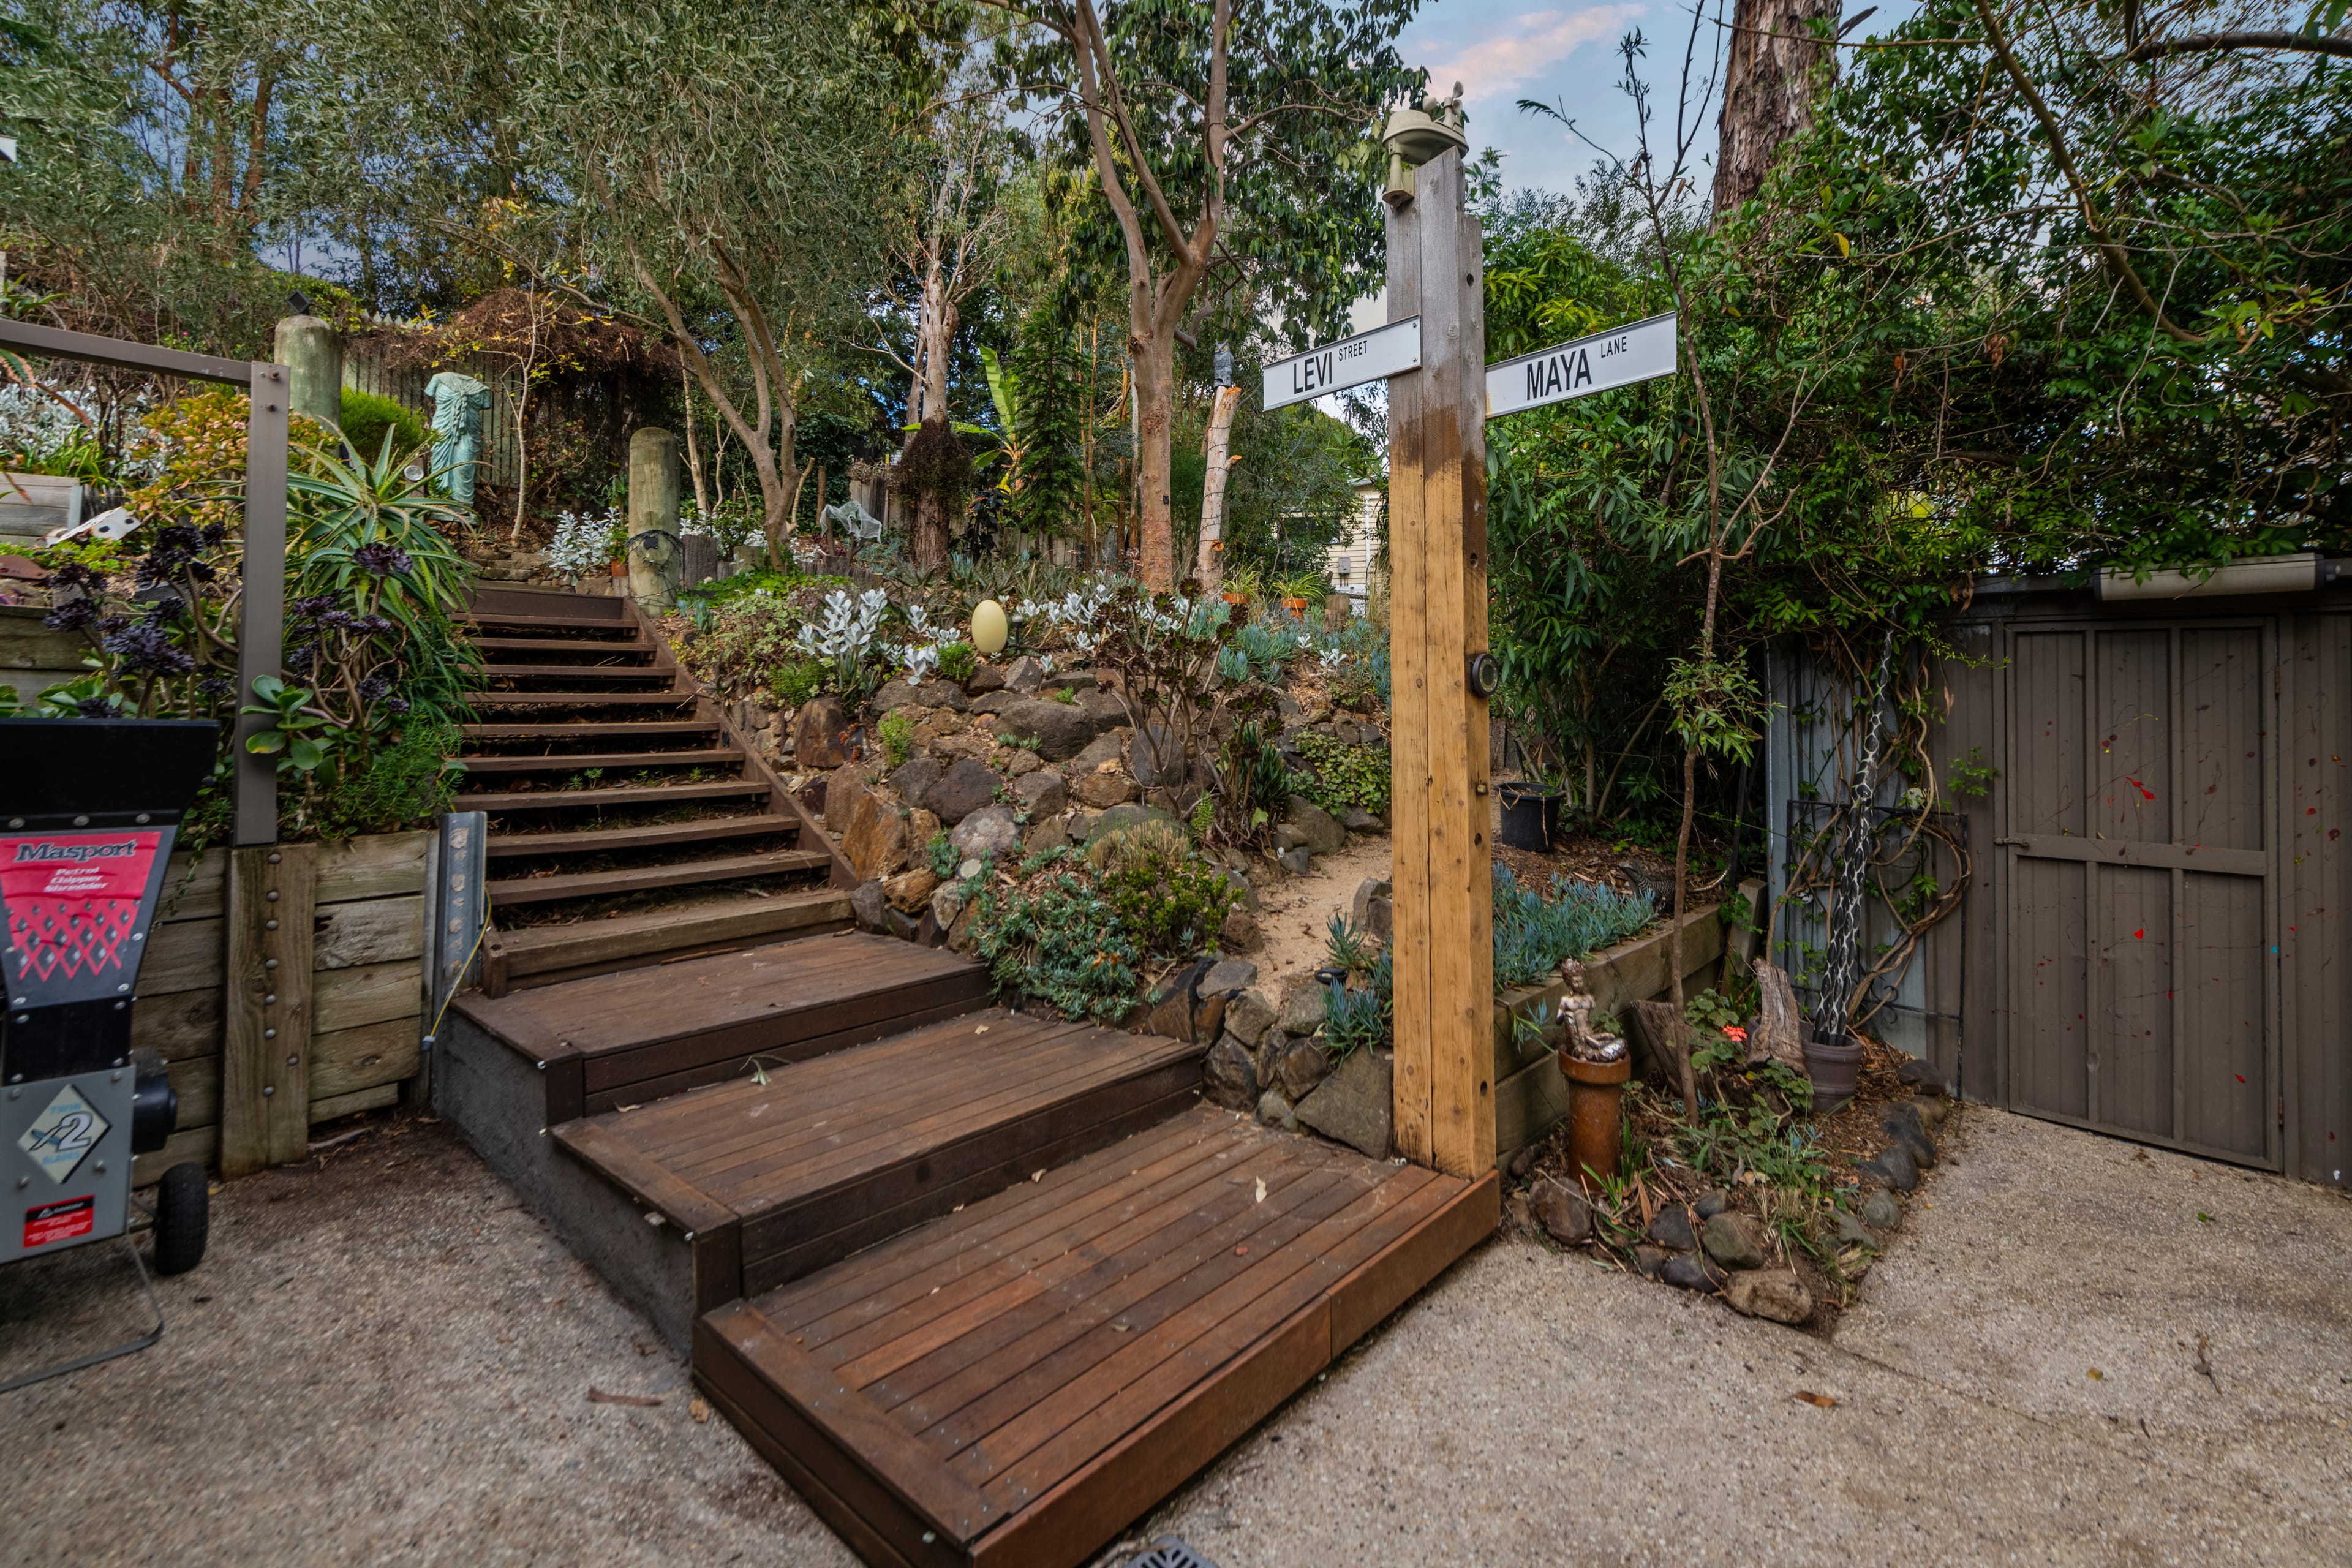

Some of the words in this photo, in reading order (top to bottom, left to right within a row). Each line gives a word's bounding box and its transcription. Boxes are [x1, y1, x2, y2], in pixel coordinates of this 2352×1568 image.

[1294, 352, 1332, 394] LEVI
[1338, 340, 1368, 361] STREET
[1527, 348, 1593, 401] MAYA
[1600, 336, 1627, 358] LANE
[15, 839, 138, 862] Masport
[55, 866, 100, 876] Petrol
[43, 883, 108, 892] Shredder
[50, 875, 104, 884] Chipper
